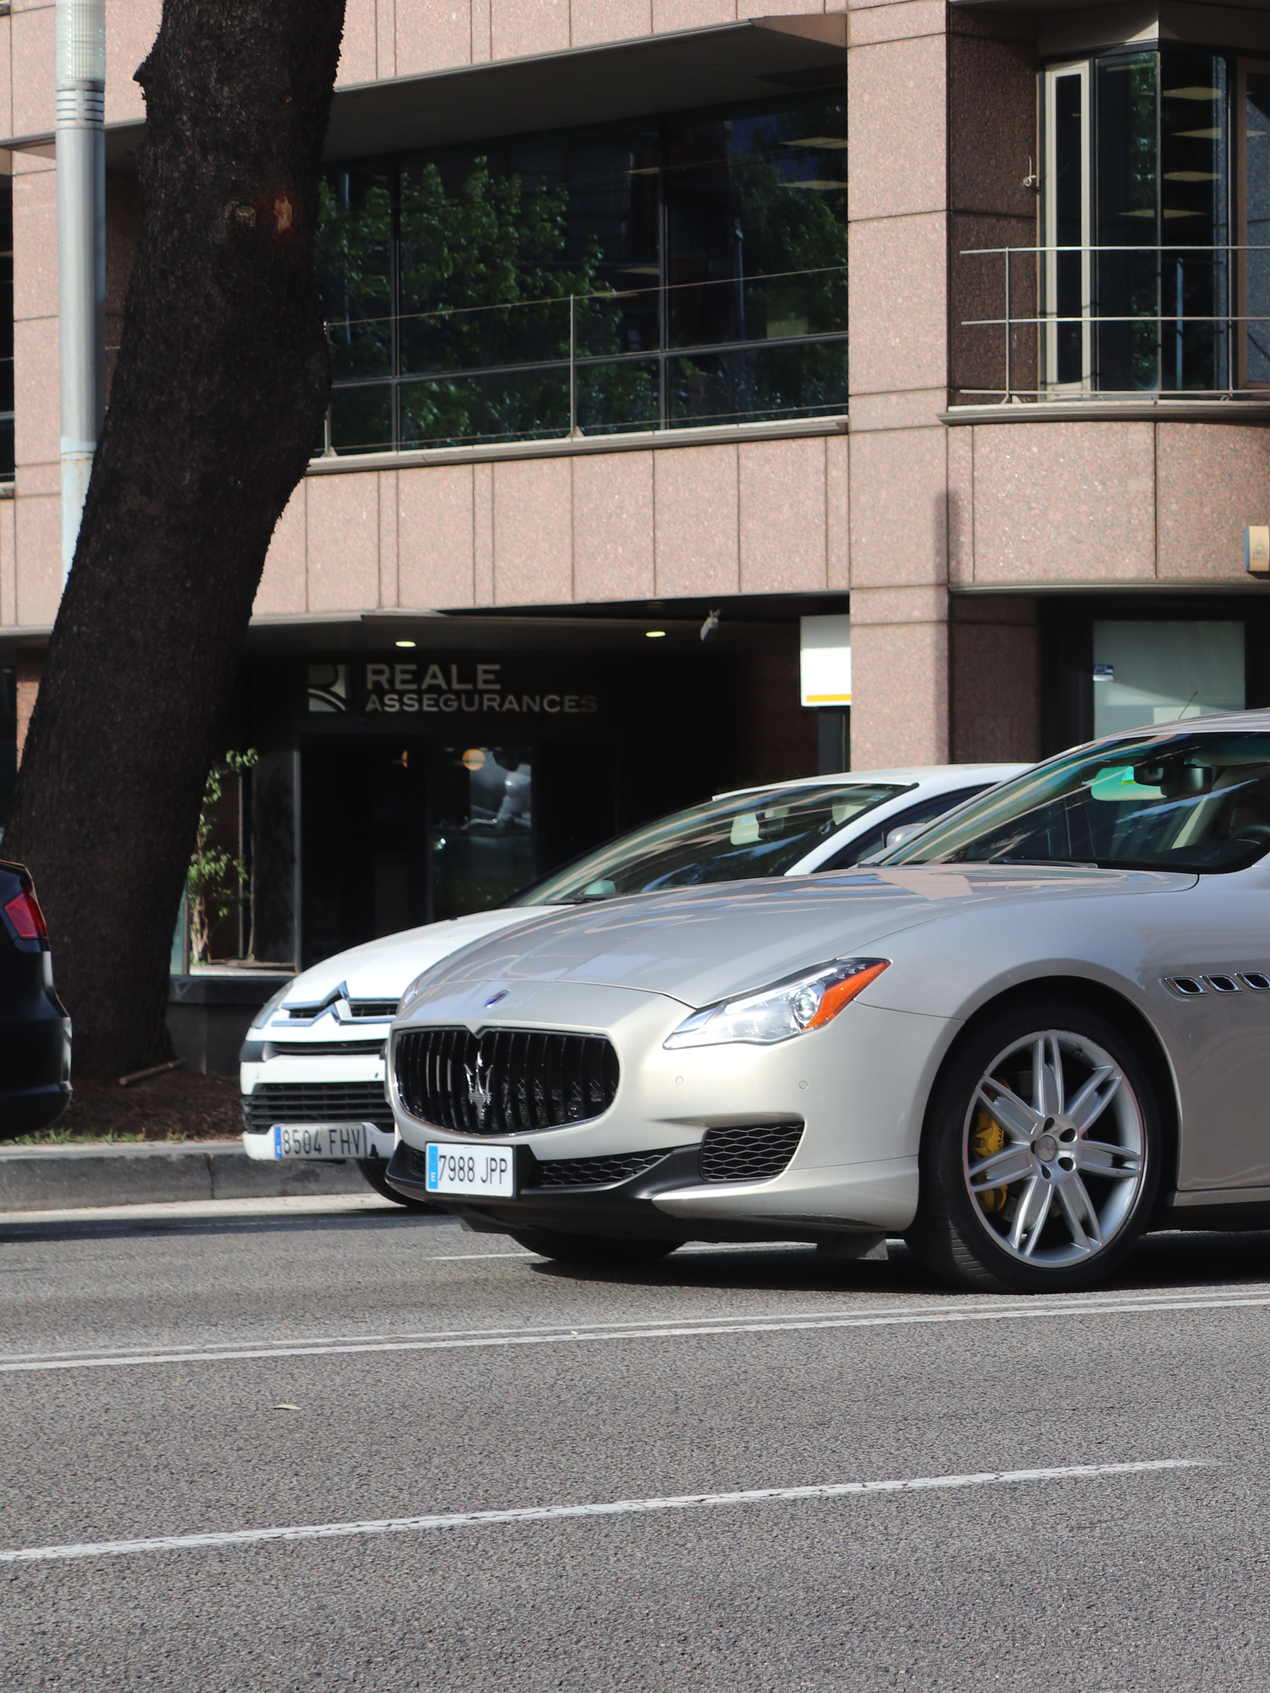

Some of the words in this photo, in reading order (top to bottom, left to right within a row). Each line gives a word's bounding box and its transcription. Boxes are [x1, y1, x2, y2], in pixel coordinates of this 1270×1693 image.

[365, 663, 501, 690] REALE
[365, 694, 598, 713] ASSEGURANCES
[283, 1129, 322, 1155] 8504
[328, 1128, 360, 1155] FHV
[439, 1154, 475, 1182] 7988
[480, 1157, 507, 1185] JPP
